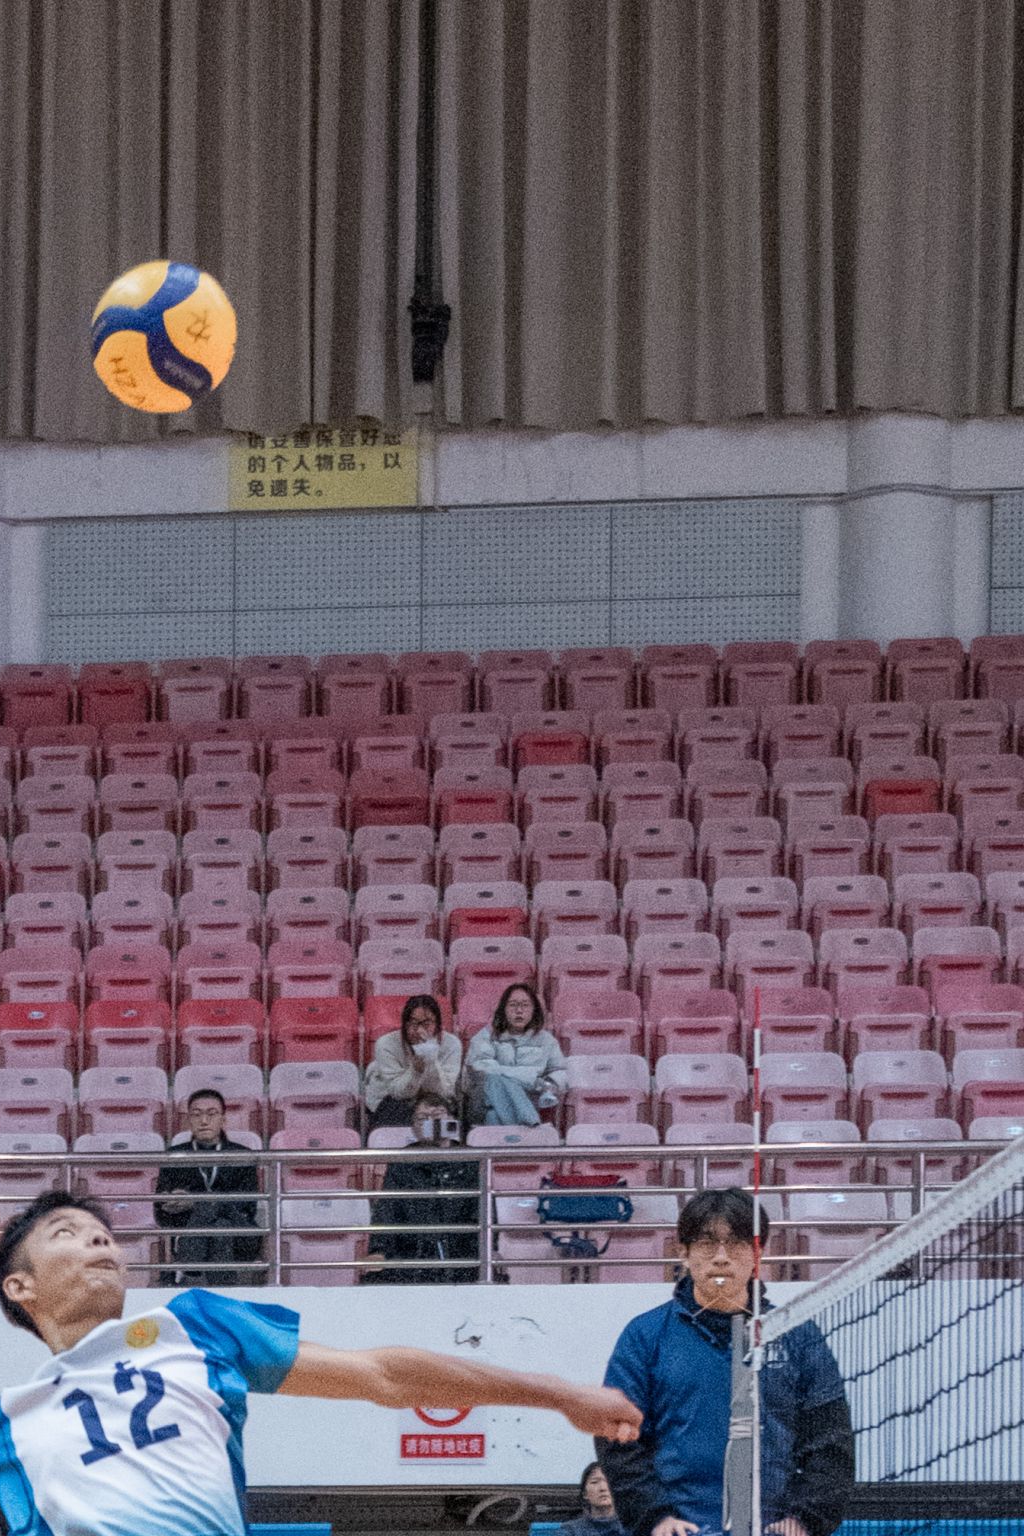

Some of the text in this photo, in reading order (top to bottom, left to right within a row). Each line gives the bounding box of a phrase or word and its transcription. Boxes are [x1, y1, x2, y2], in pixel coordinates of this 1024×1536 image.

[247, 479, 326, 498] 免遗失。
[62, 1361, 181, 1466] 12
